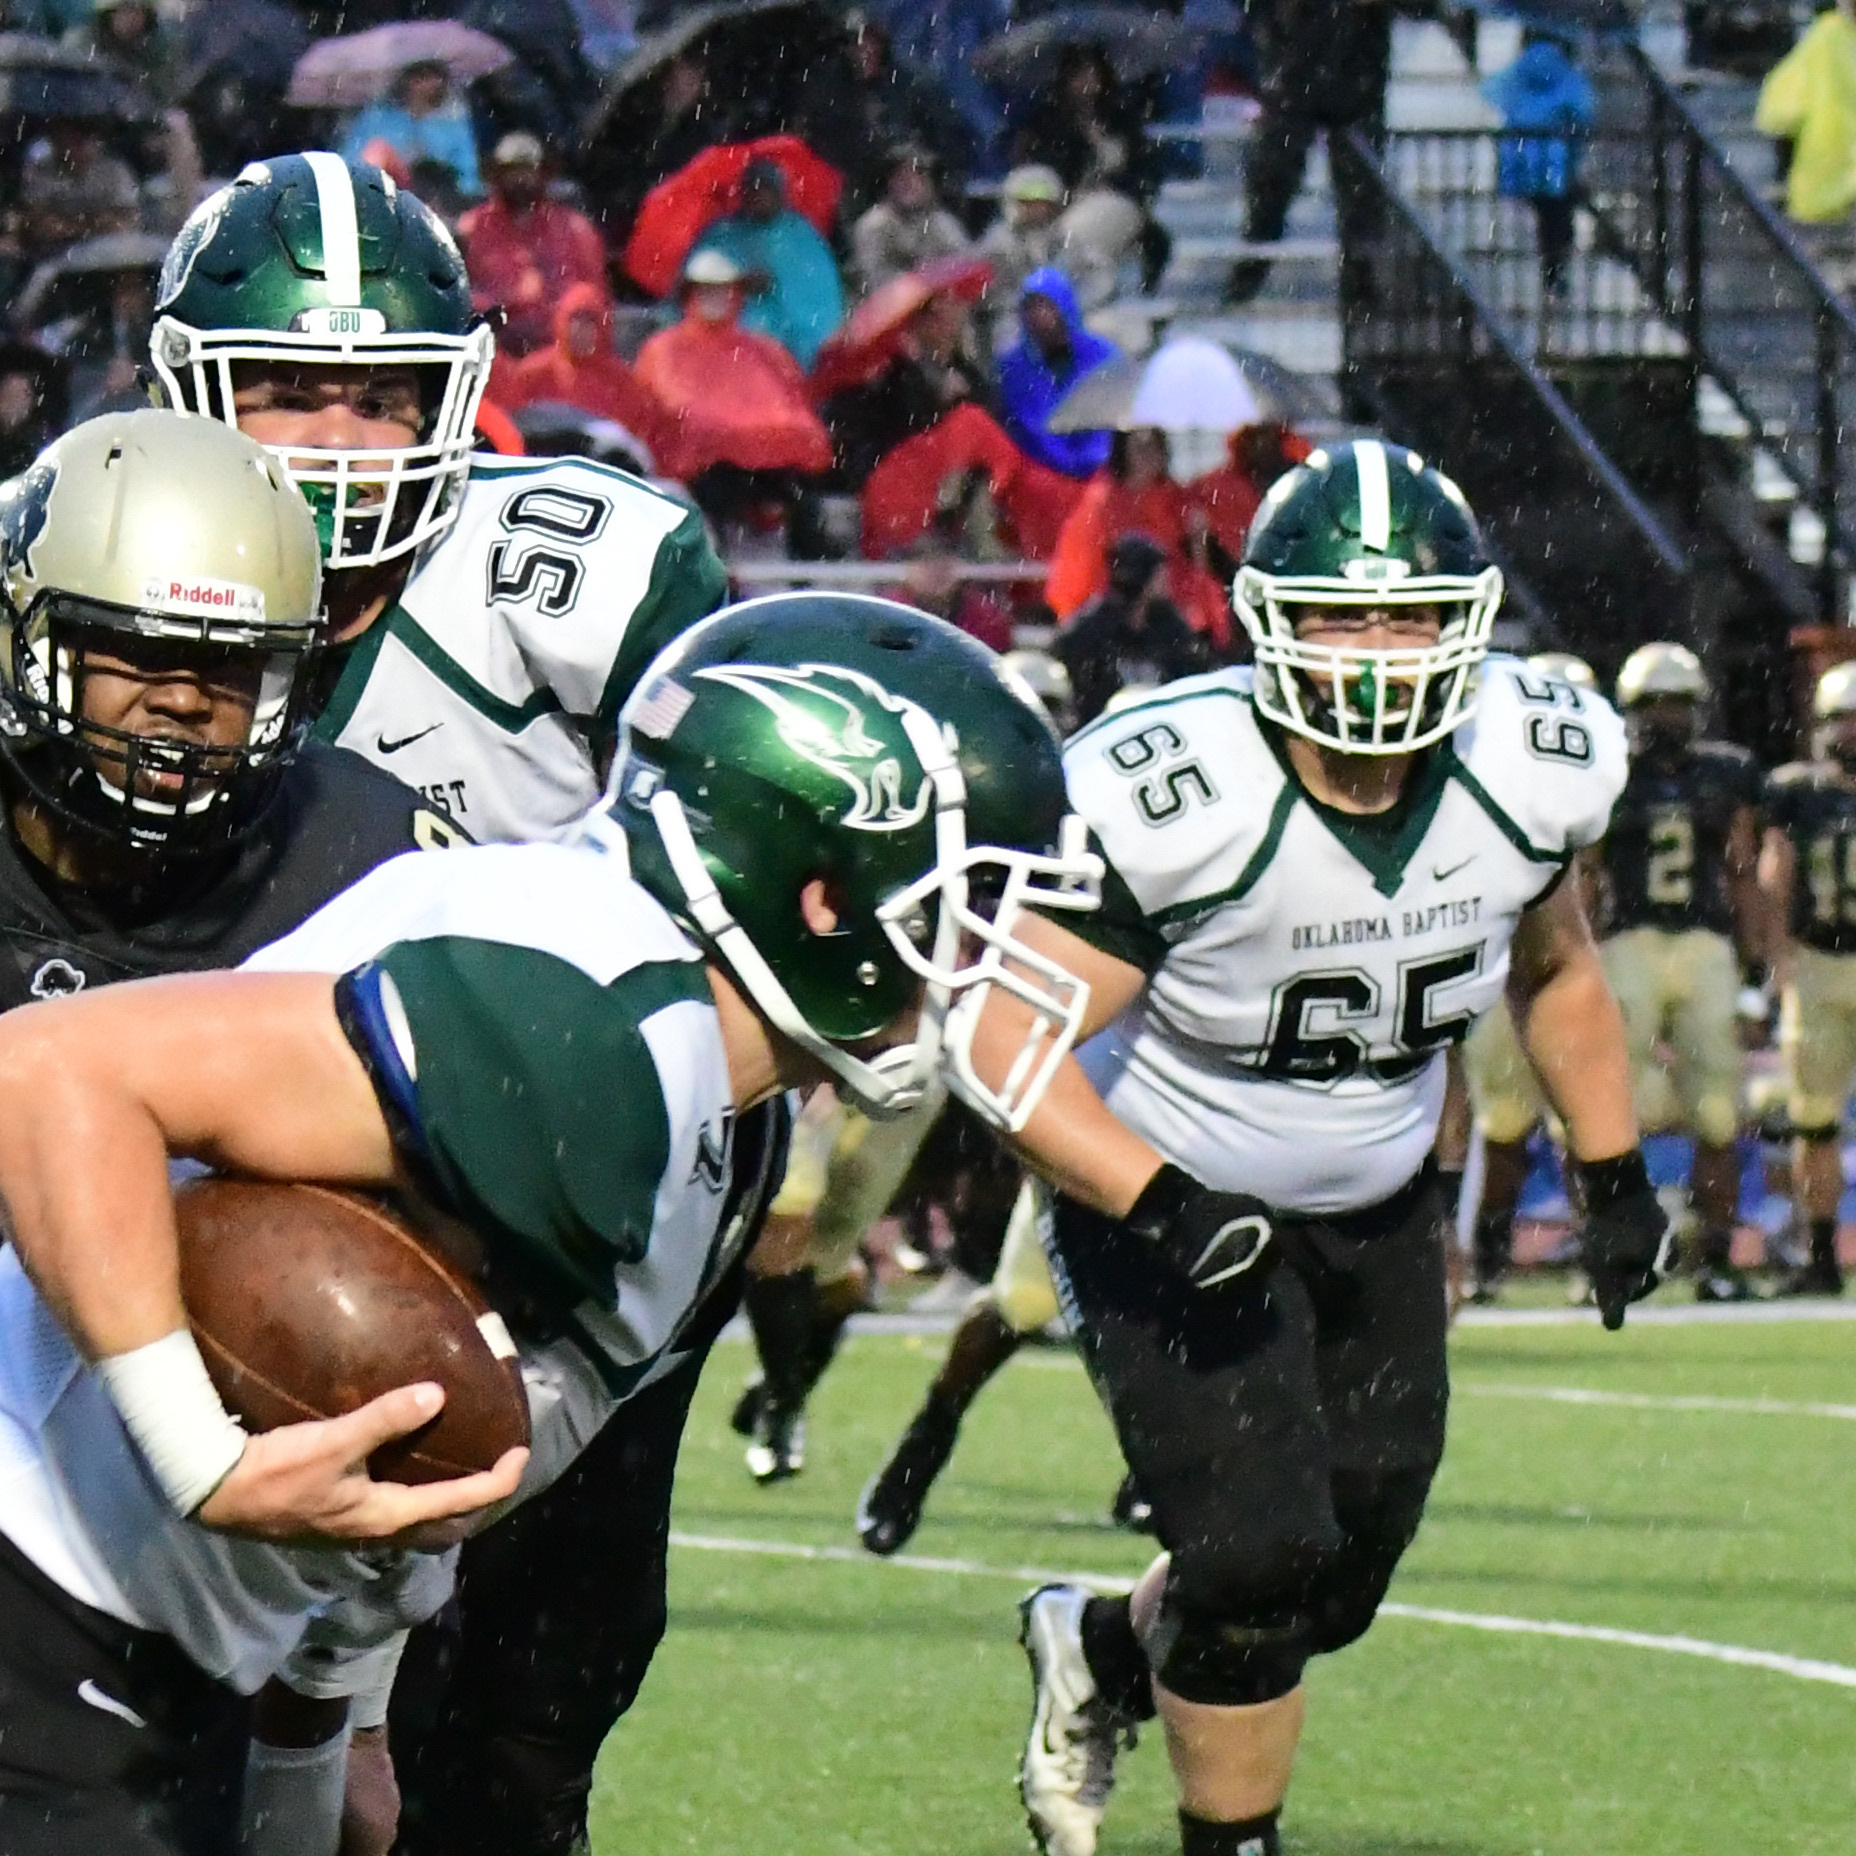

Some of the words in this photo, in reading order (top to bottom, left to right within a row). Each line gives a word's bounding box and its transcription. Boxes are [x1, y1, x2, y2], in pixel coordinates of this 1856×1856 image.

[328, 311, 361, 333] OBU
[485, 484, 614, 619] 50
[169, 582, 235, 608] Riddell
[1103, 724, 1220, 828] 65
[1648, 819, 1696, 905] 2
[1292, 917, 1393, 950] OKLAHOMA
[1403, 897, 1483, 937] BAPTIST
[1263, 939, 1488, 1094] 65
